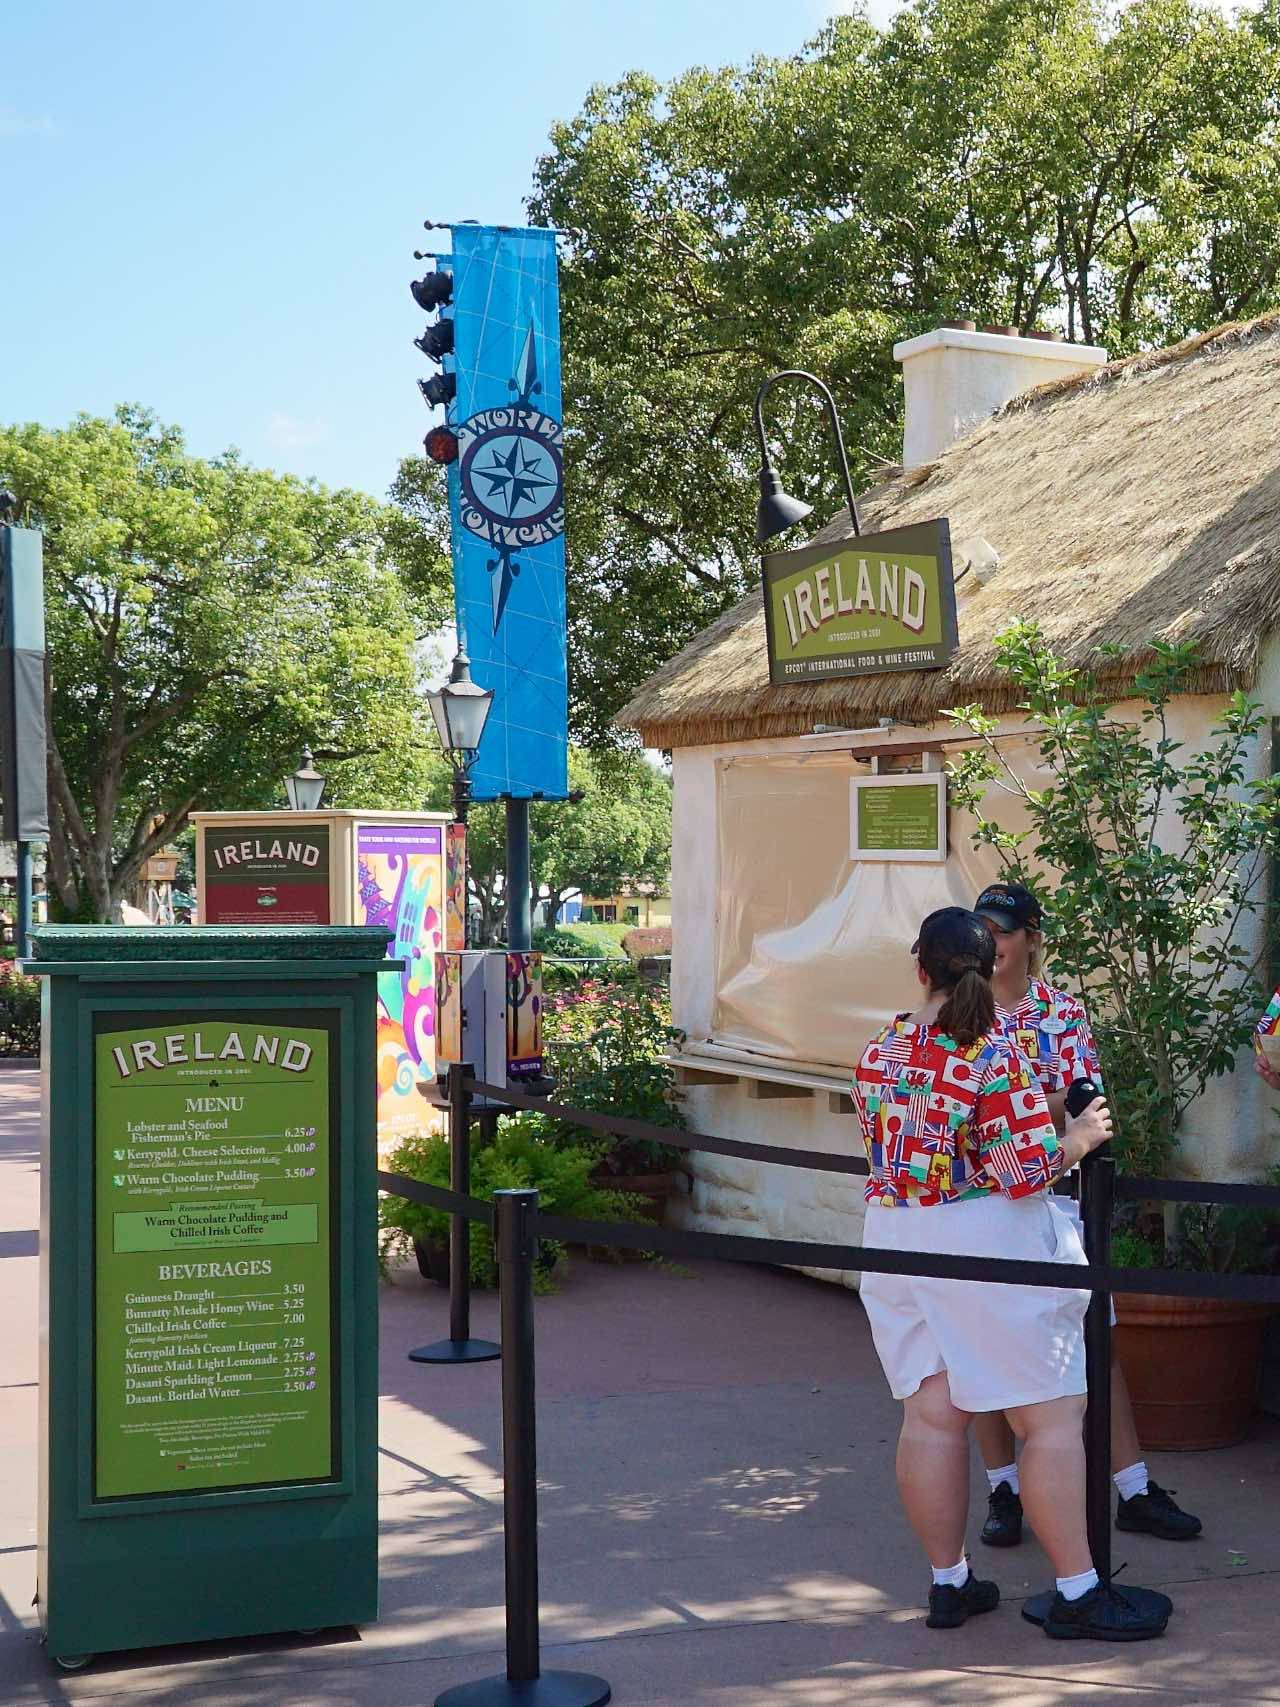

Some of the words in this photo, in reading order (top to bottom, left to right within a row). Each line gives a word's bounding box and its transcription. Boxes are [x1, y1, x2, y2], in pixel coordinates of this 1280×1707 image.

[783, 559, 926, 651] IRELAND
[828, 631, 860, 642] INTRODUCED
[861, 629, 868, 639] IN
[808, 660, 855, 672] INTERNATIONAL
[858, 656, 875, 667] FOOD
[878, 656, 882, 665] &
[885, 654, 902, 664] WINE
[905, 650, 935, 662] FESTIVAL
[213, 839, 320, 869] IRELAND
[112, 1032, 312, 1077] IRELAND
[185, 1097, 244, 1113] MENU
[127, 1121, 167, 1133] Lobster
[168, 1120, 186, 1131] and
[188, 1119, 228, 1130] Seafood
[131, 1131, 192, 1143] Fisherman's
[194, 1131, 210, 1141] Pie
[284, 1127, 305, 1138] 6.25
[128, 1147, 177, 1161] Kerrygold
[183, 1147, 218, 1157] Cheese
[220, 1146, 266, 1156] Selection
[284, 1143, 306, 1153] 4.00
[127, 1175, 159, 1185] Warm
[162, 1173, 214, 1184] Chocolate
[216, 1171, 260, 1183] Pudding
[284, 1168, 305, 1178] 3.50
[145, 1216, 176, 1227] Warm
[178, 1214, 226, 1225] Chocolate
[229, 1213, 269, 1224] Pudding
[270, 1211, 288, 1221] and
[170, 1226, 206, 1238] Chilled
[208, 1225, 231, 1236] Irish
[233, 1225, 264, 1235] Coffee
[159, 1260, 272, 1280] BEVERAGES
[126, 1293, 172, 1304] Guinness
[174, 1289, 214, 1302] Draught
[283, 1284, 305, 1295] 3.50
[126, 1308, 171, 1320] Bunratty
[174, 1305, 208, 1317] Meade
[211, 1303, 244, 1316] Honey
[246, 1301, 274, 1312] Wine
[282, 1298, 305, 1309] 5.25
[126, 1323, 165, 1335] Chilled
[166, 1322, 191, 1332] Irish
[193, 1320, 227, 1330] Coffee
[283, 1313, 305, 1324] 7.00
[126, 1349, 175, 1362] Kerrygold
[177, 1345, 201, 1356] Irish
[203, 1343, 236, 1354] Cream
[238, 1341, 277, 1353] Liqueur
[283, 1338, 305, 1348] 7.25
[126, 1363, 164, 1375] Minute
[166, 1361, 192, 1371] Maid
[197, 1358, 225, 1370] Light
[227, 1355, 278, 1367] Lemonade
[283, 1352, 305, 1363] 2.75
[126, 1378, 163, 1390] Dasani
[166, 1374, 214, 1387] Sparkling
[216, 1372, 252, 1382] Lemon
[284, 1367, 305, 1378] 2.75
[126, 1394, 162, 1405] Dasani
[168, 1390, 206, 1401] Bottled
[208, 1388, 241, 1398] Water
[284, 1382, 305, 1393] 2.50
